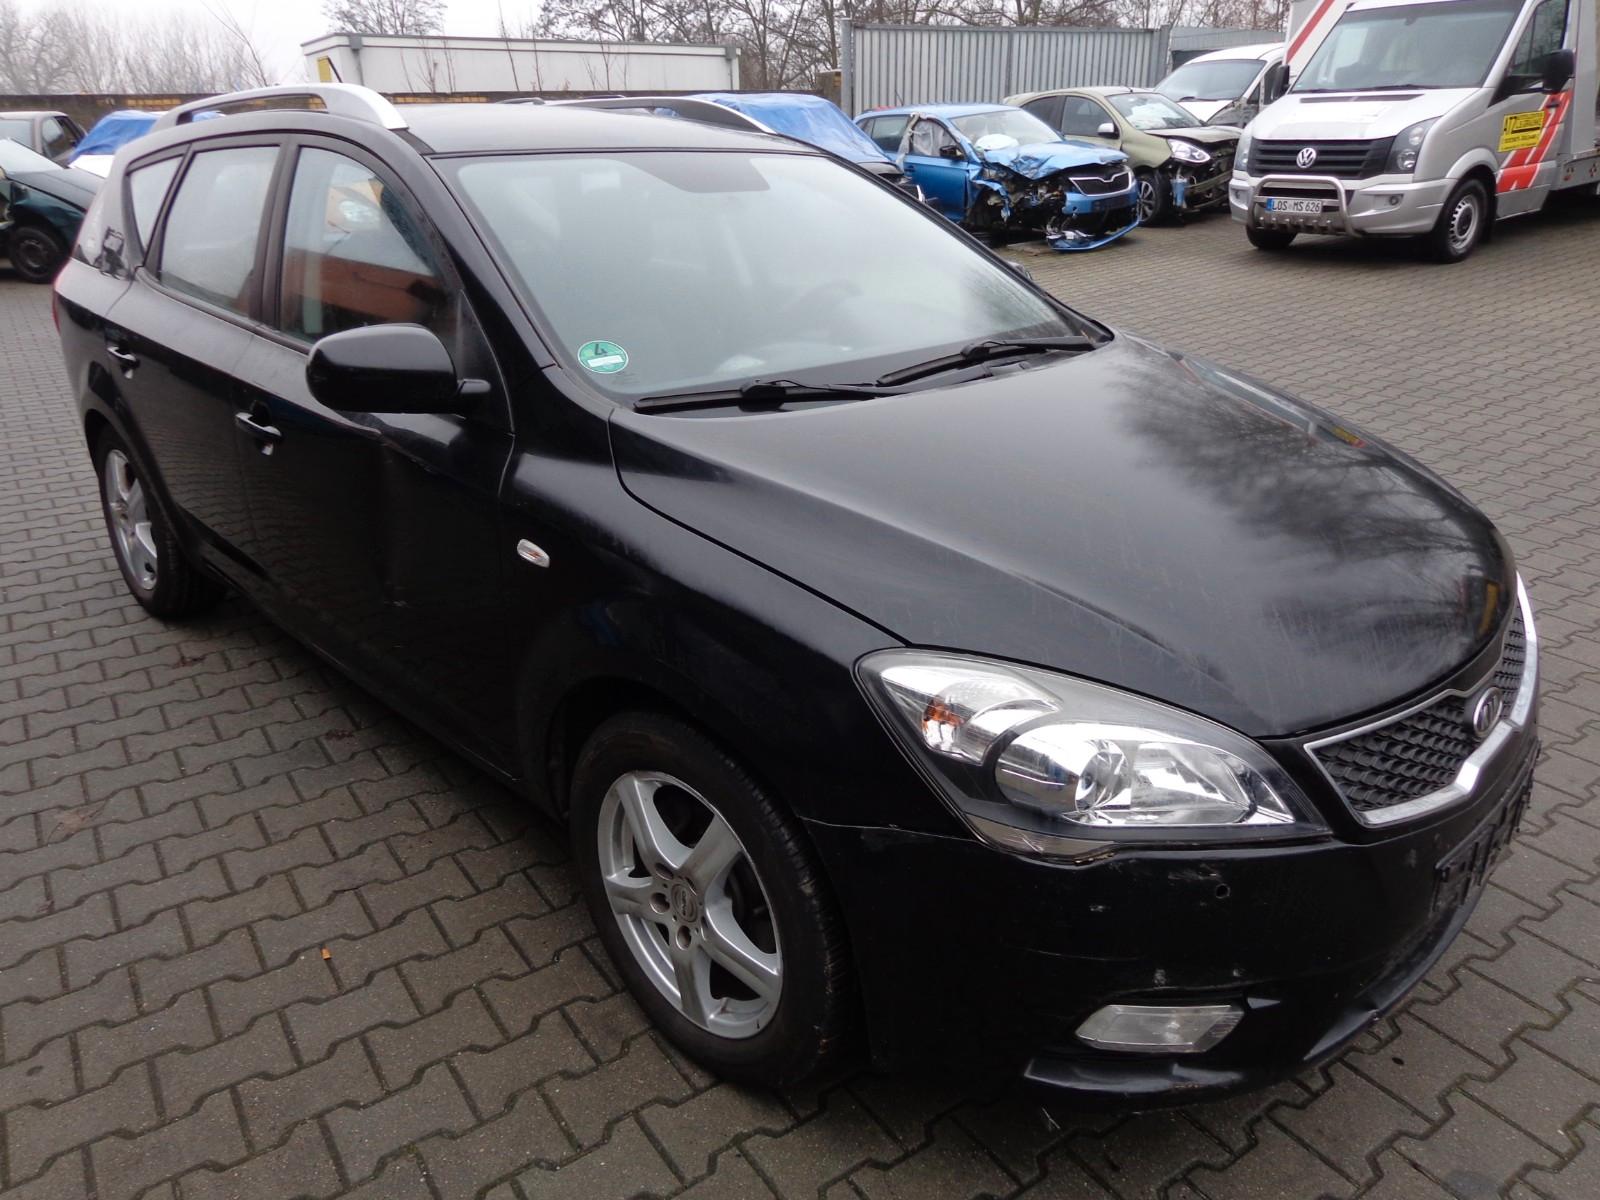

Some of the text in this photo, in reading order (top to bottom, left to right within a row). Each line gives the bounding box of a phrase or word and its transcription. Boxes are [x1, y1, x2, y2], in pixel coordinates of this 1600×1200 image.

[1272, 200, 1320, 213] LOS MS 626
